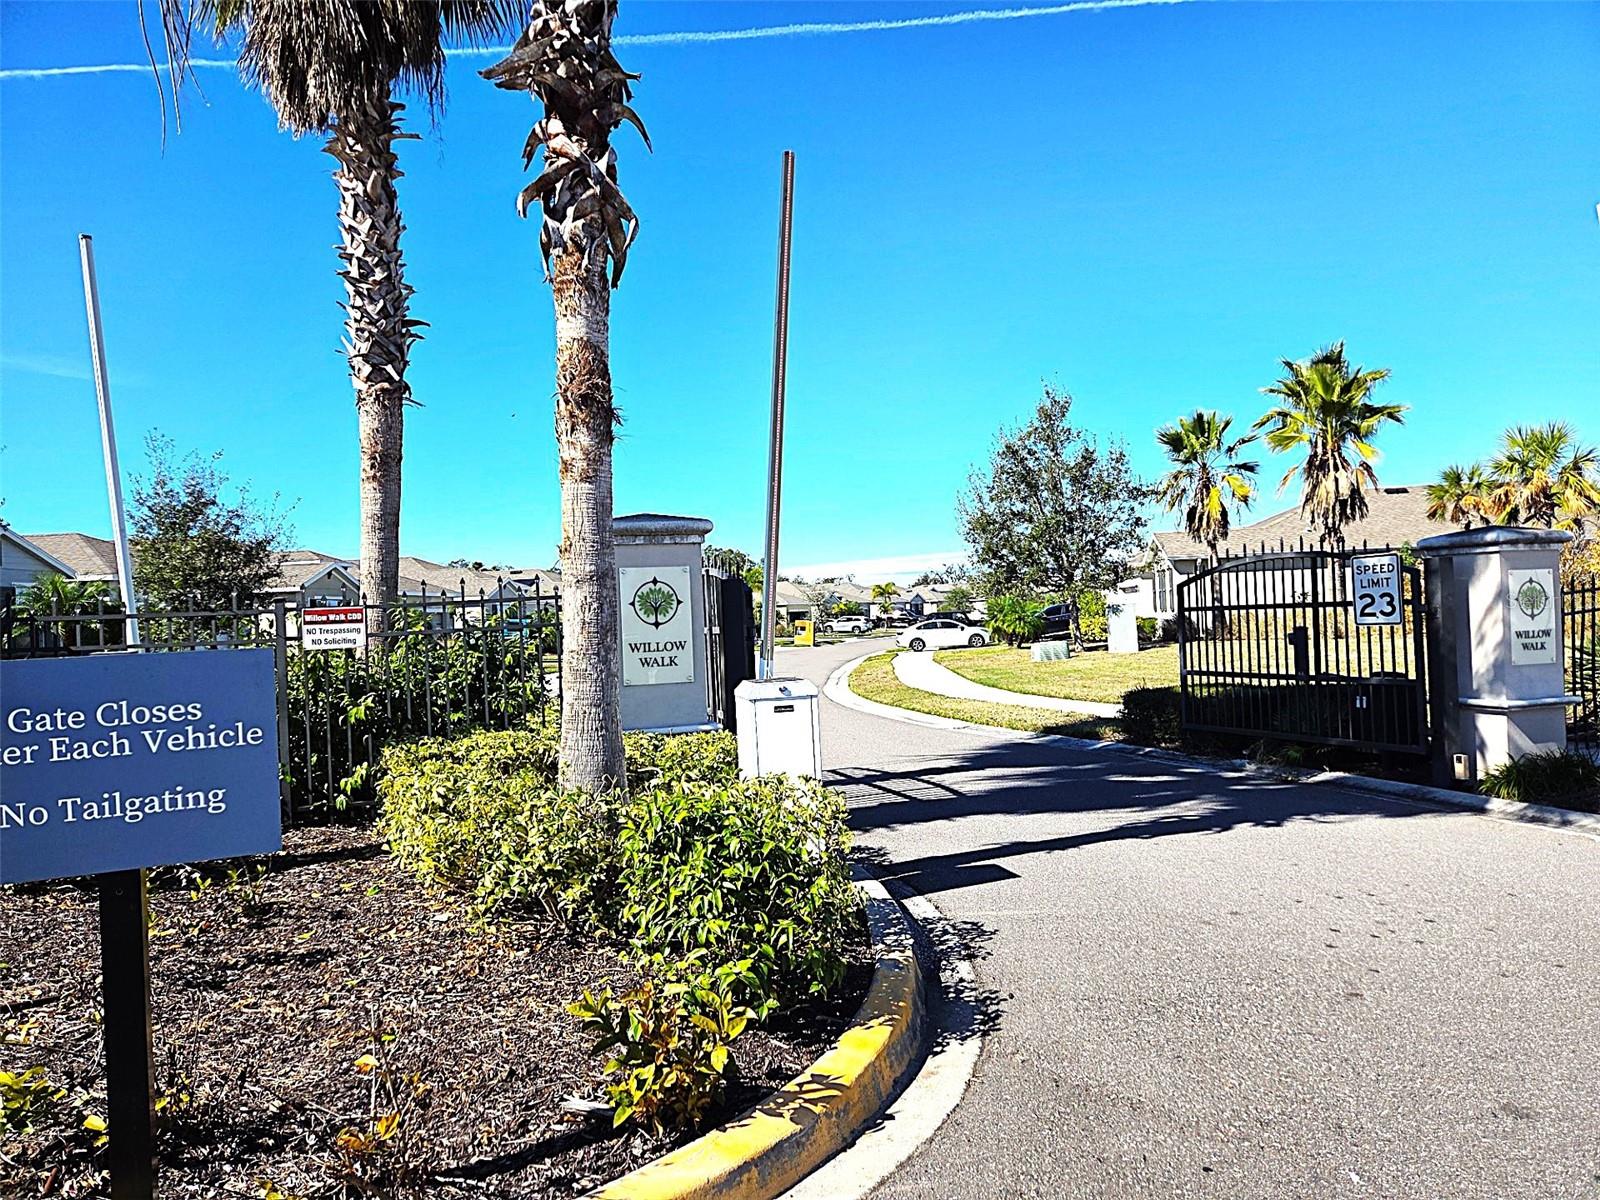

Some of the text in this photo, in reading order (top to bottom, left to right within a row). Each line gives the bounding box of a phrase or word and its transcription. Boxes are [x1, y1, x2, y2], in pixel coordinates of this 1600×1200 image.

[1356, 563, 1395, 575] SPEED
[1360, 577, 1391, 588] LIMIT
[1358, 592, 1396, 617] 23
[318, 627, 361, 635] Trespassing
[1515, 629, 1552, 639] WILLOW
[323, 637, 357, 645] Soliciting
[628, 640, 688, 654] WILLOW
[1521, 642, 1547, 651] WALK
[639, 655, 679, 668] WALK
[7, 700, 202, 734] Gate Closes
[0, 721, 264, 766] er Each Vehicle
[0, 785, 227, 829] No Tailgating
